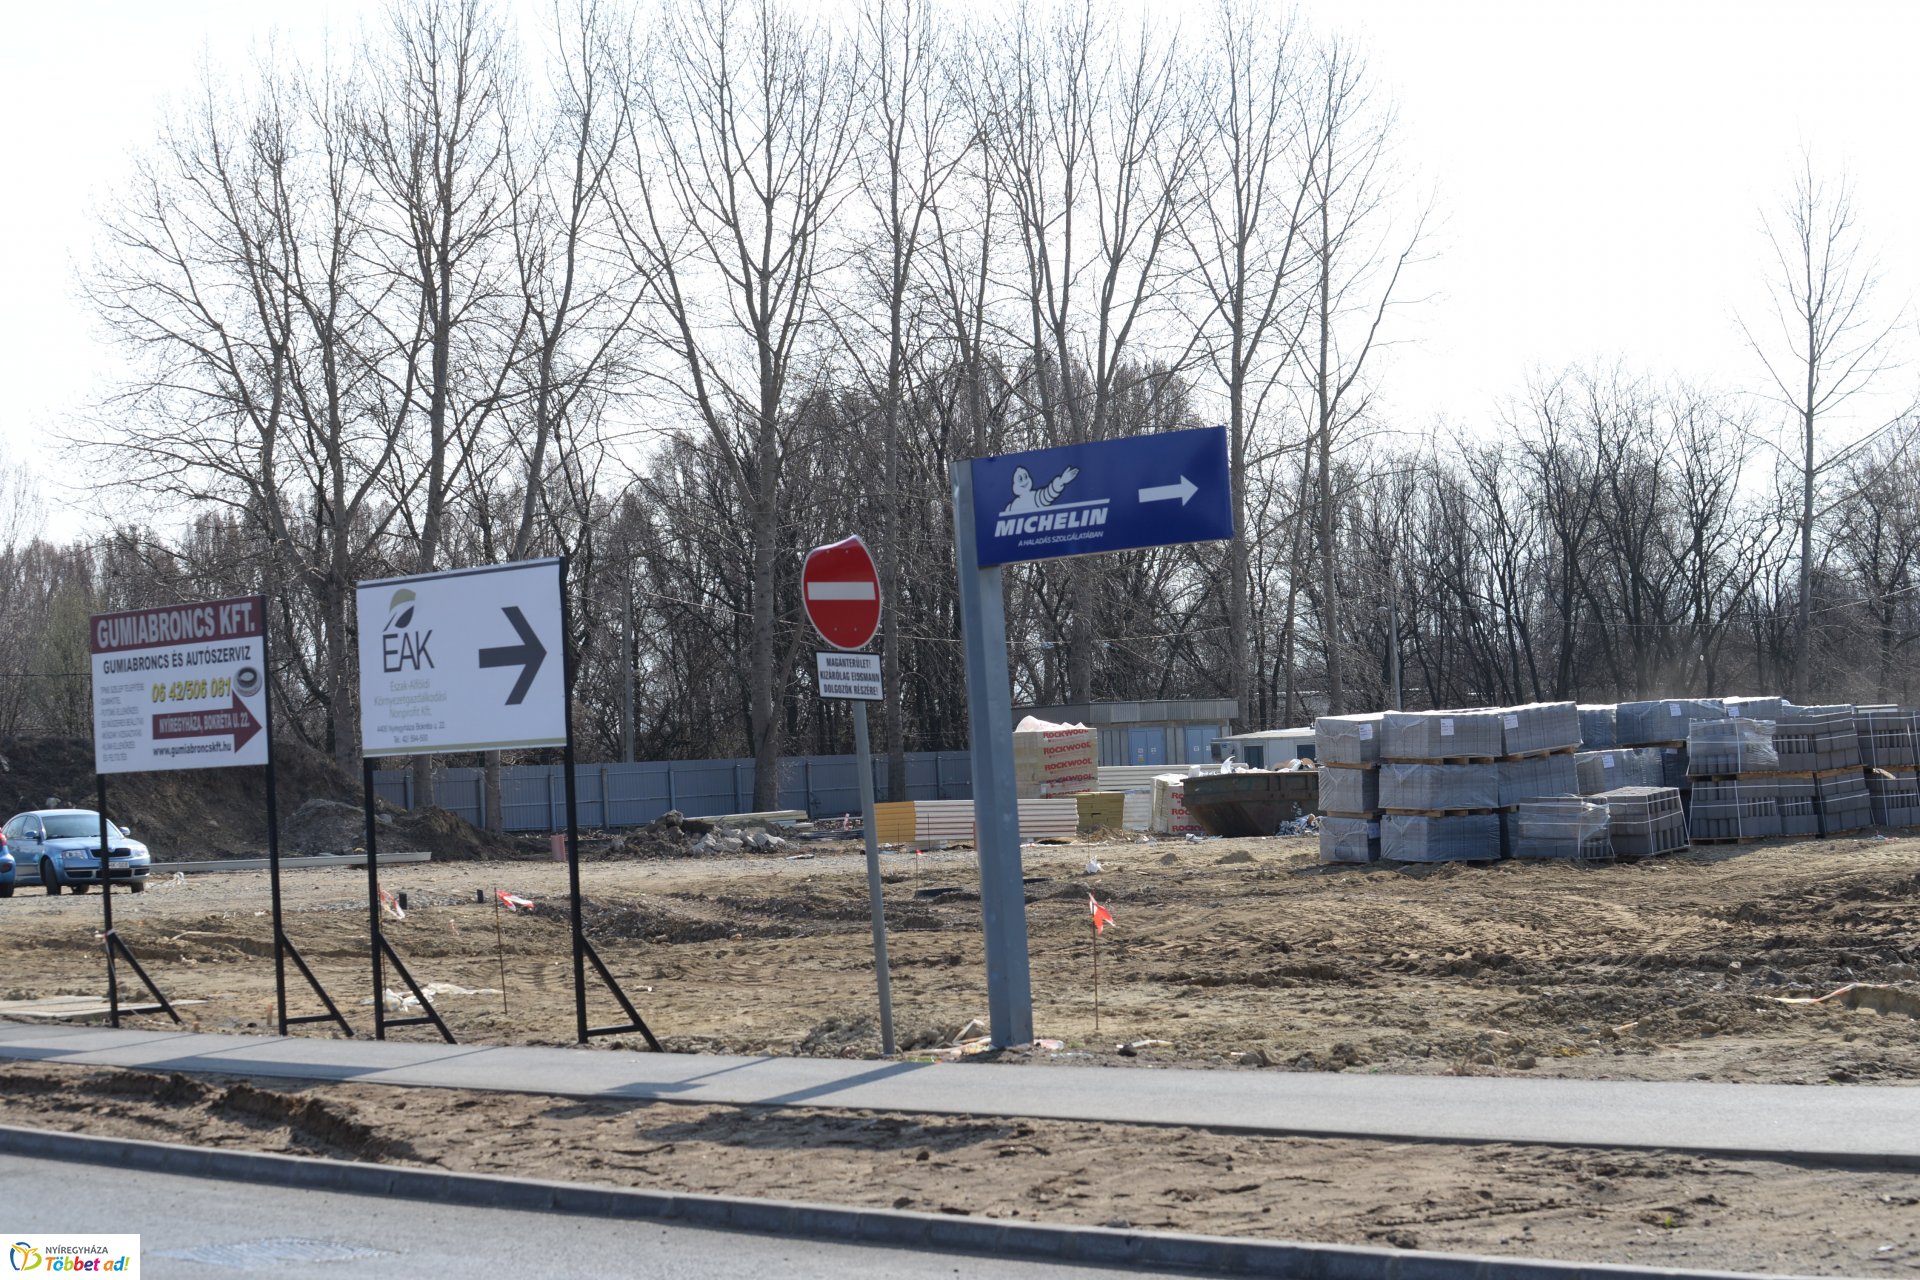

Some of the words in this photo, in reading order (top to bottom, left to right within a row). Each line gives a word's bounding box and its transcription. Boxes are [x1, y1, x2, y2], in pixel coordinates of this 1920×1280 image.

[994, 507, 1108, 538] MICHELIN
[1023, 536, 1052, 546] HALADÁS
[1051, 530, 1104, 544] SZOLGÁLATÁBAN
[97, 607, 216, 649] GUMIABRONCS
[219, 602, 256, 635] KFT.
[103, 654, 169, 675] GUMIABRONCS
[171, 650, 184, 668] ÉS
[186, 645, 251, 666] AUTÓSZERVIZ
[820, 668, 850, 682] KIZÁRÓLAG
[851, 672, 880, 683] EISSMANN
[152, 683, 166, 703] 06
[169, 678, 207, 702] 42/506
[211, 676, 232, 698] 081
[823, 683, 852, 695] DOLGOZÓK
[160, 712, 204, 734] NYÍREGYHÁZA,
[204, 710, 232, 731] BOKRÉTA
[153, 741, 232, 758] www.gumiabroncskft.hu
[1043, 742, 1092, 755] ROCKWOOL
[1045, 758, 1093, 771] ROCKWOOL
